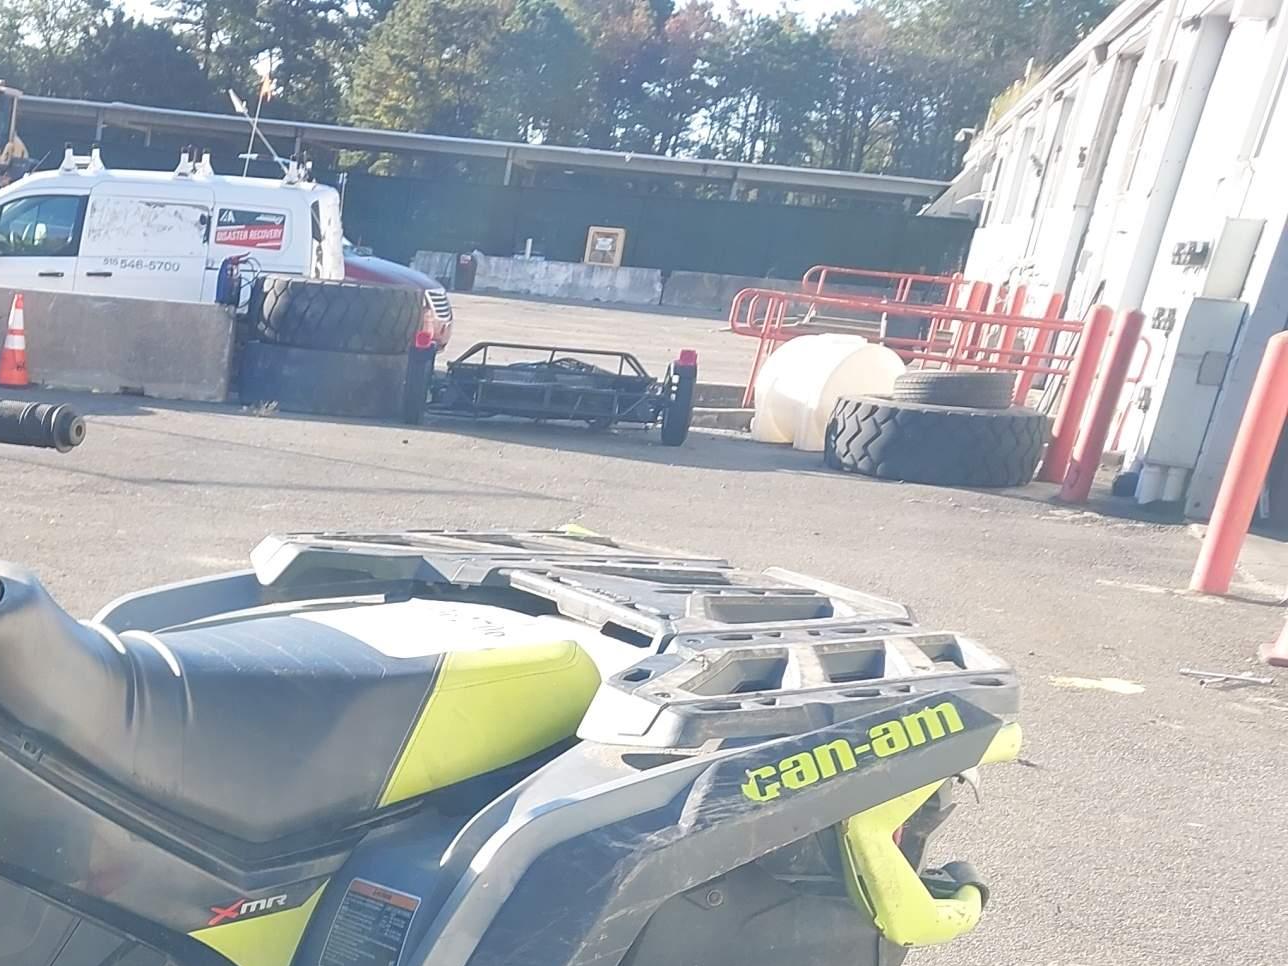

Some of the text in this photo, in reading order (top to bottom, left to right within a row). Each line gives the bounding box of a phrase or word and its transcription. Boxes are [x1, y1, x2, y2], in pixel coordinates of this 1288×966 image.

[215, 227, 283, 241] DISASTER RECOVERY
[740, 702, 965, 803] can-am
